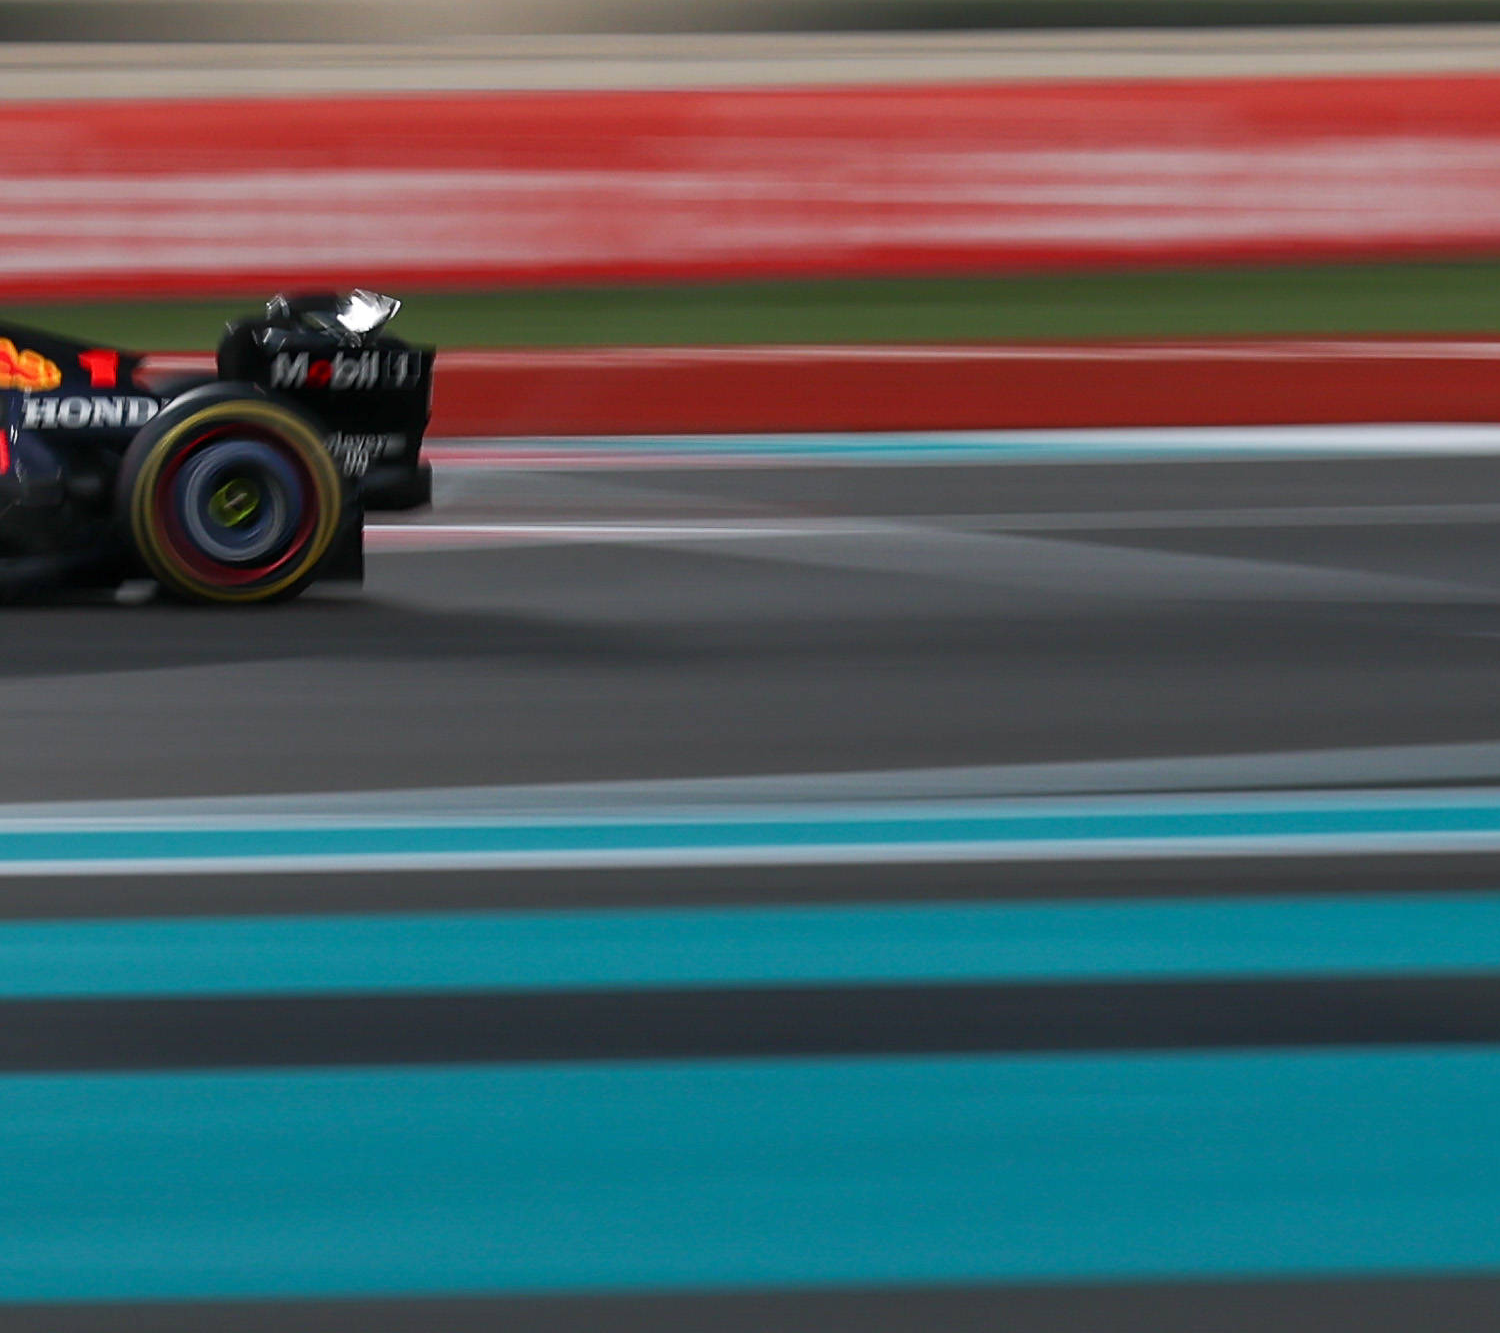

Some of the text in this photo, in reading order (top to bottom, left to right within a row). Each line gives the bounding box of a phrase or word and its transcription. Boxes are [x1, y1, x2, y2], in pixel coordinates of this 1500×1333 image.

[77, 348, 119, 389] 1
[270, 351, 381, 390] Mobil
[22, 396, 172, 429] HOND
